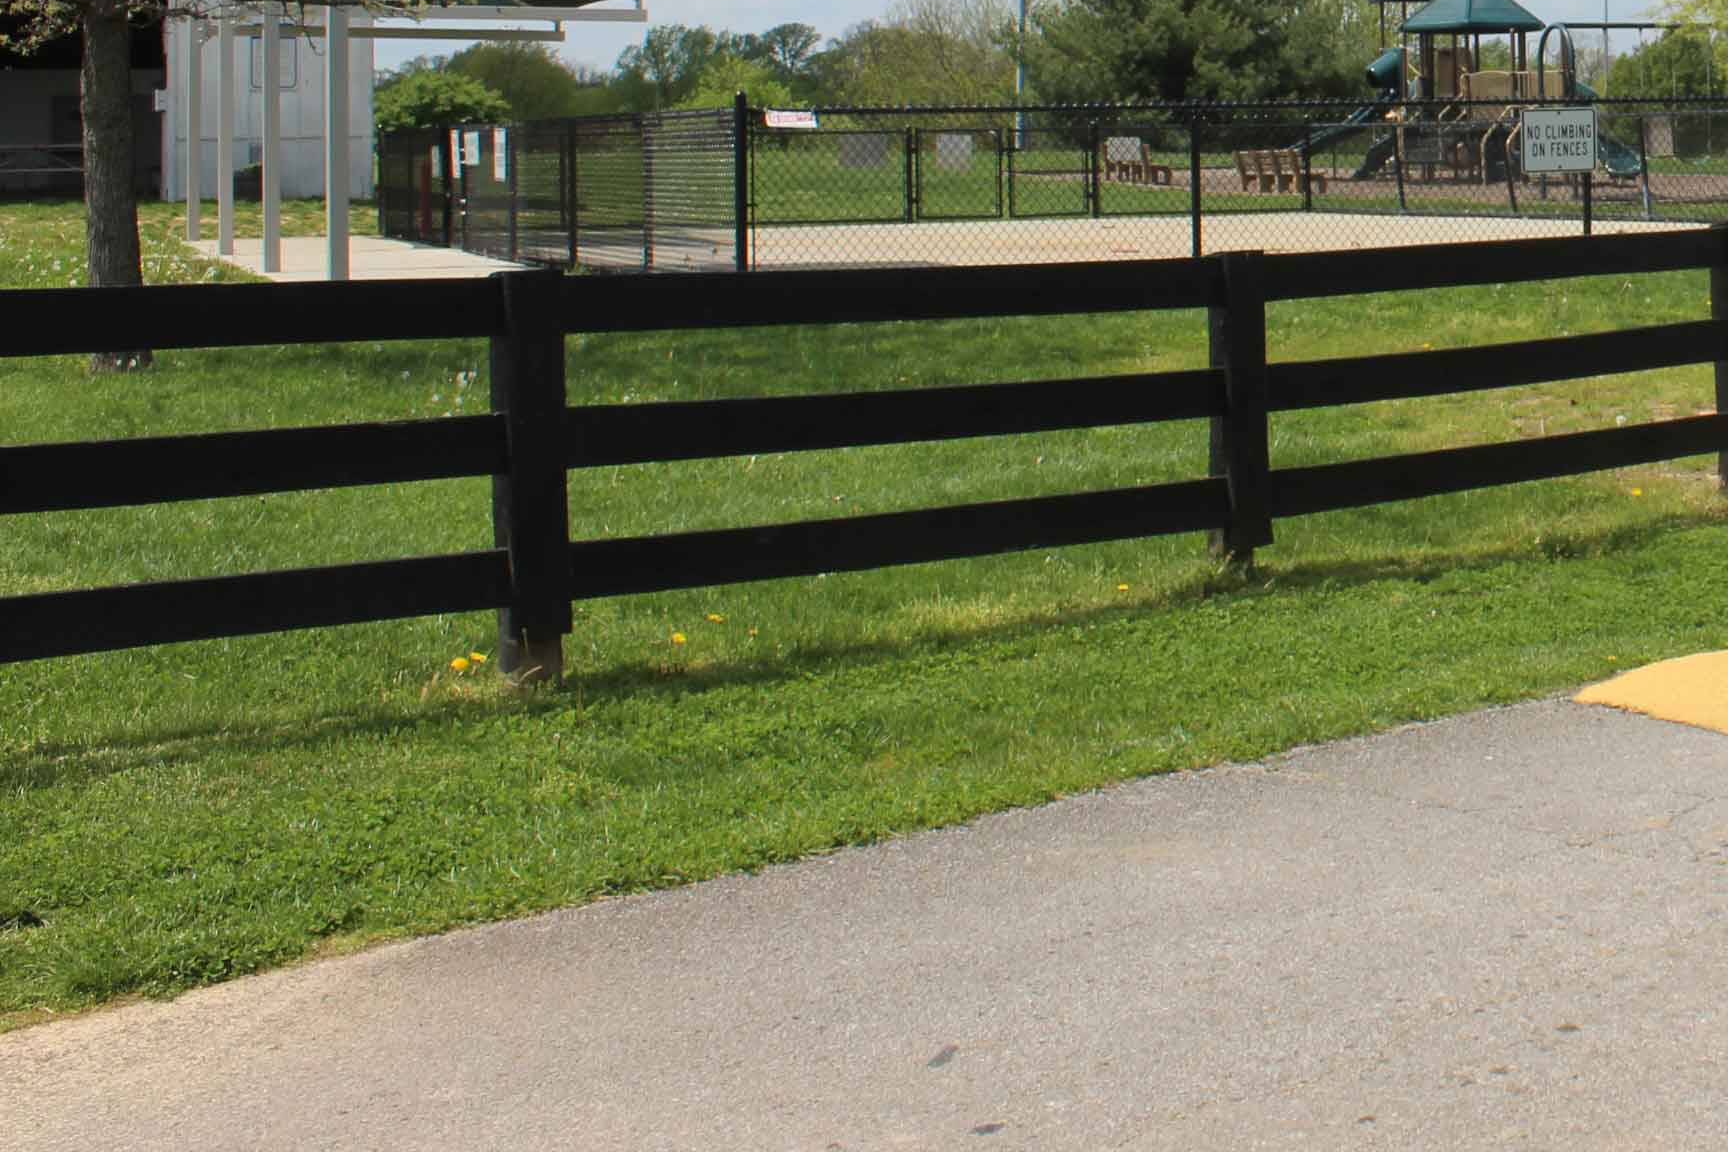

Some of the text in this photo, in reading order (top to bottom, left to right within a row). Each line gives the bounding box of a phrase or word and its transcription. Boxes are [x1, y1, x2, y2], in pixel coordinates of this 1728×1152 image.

[1527, 124, 1592, 140] NO CLIMBING
[1532, 142, 1588, 157] ON FENCES
